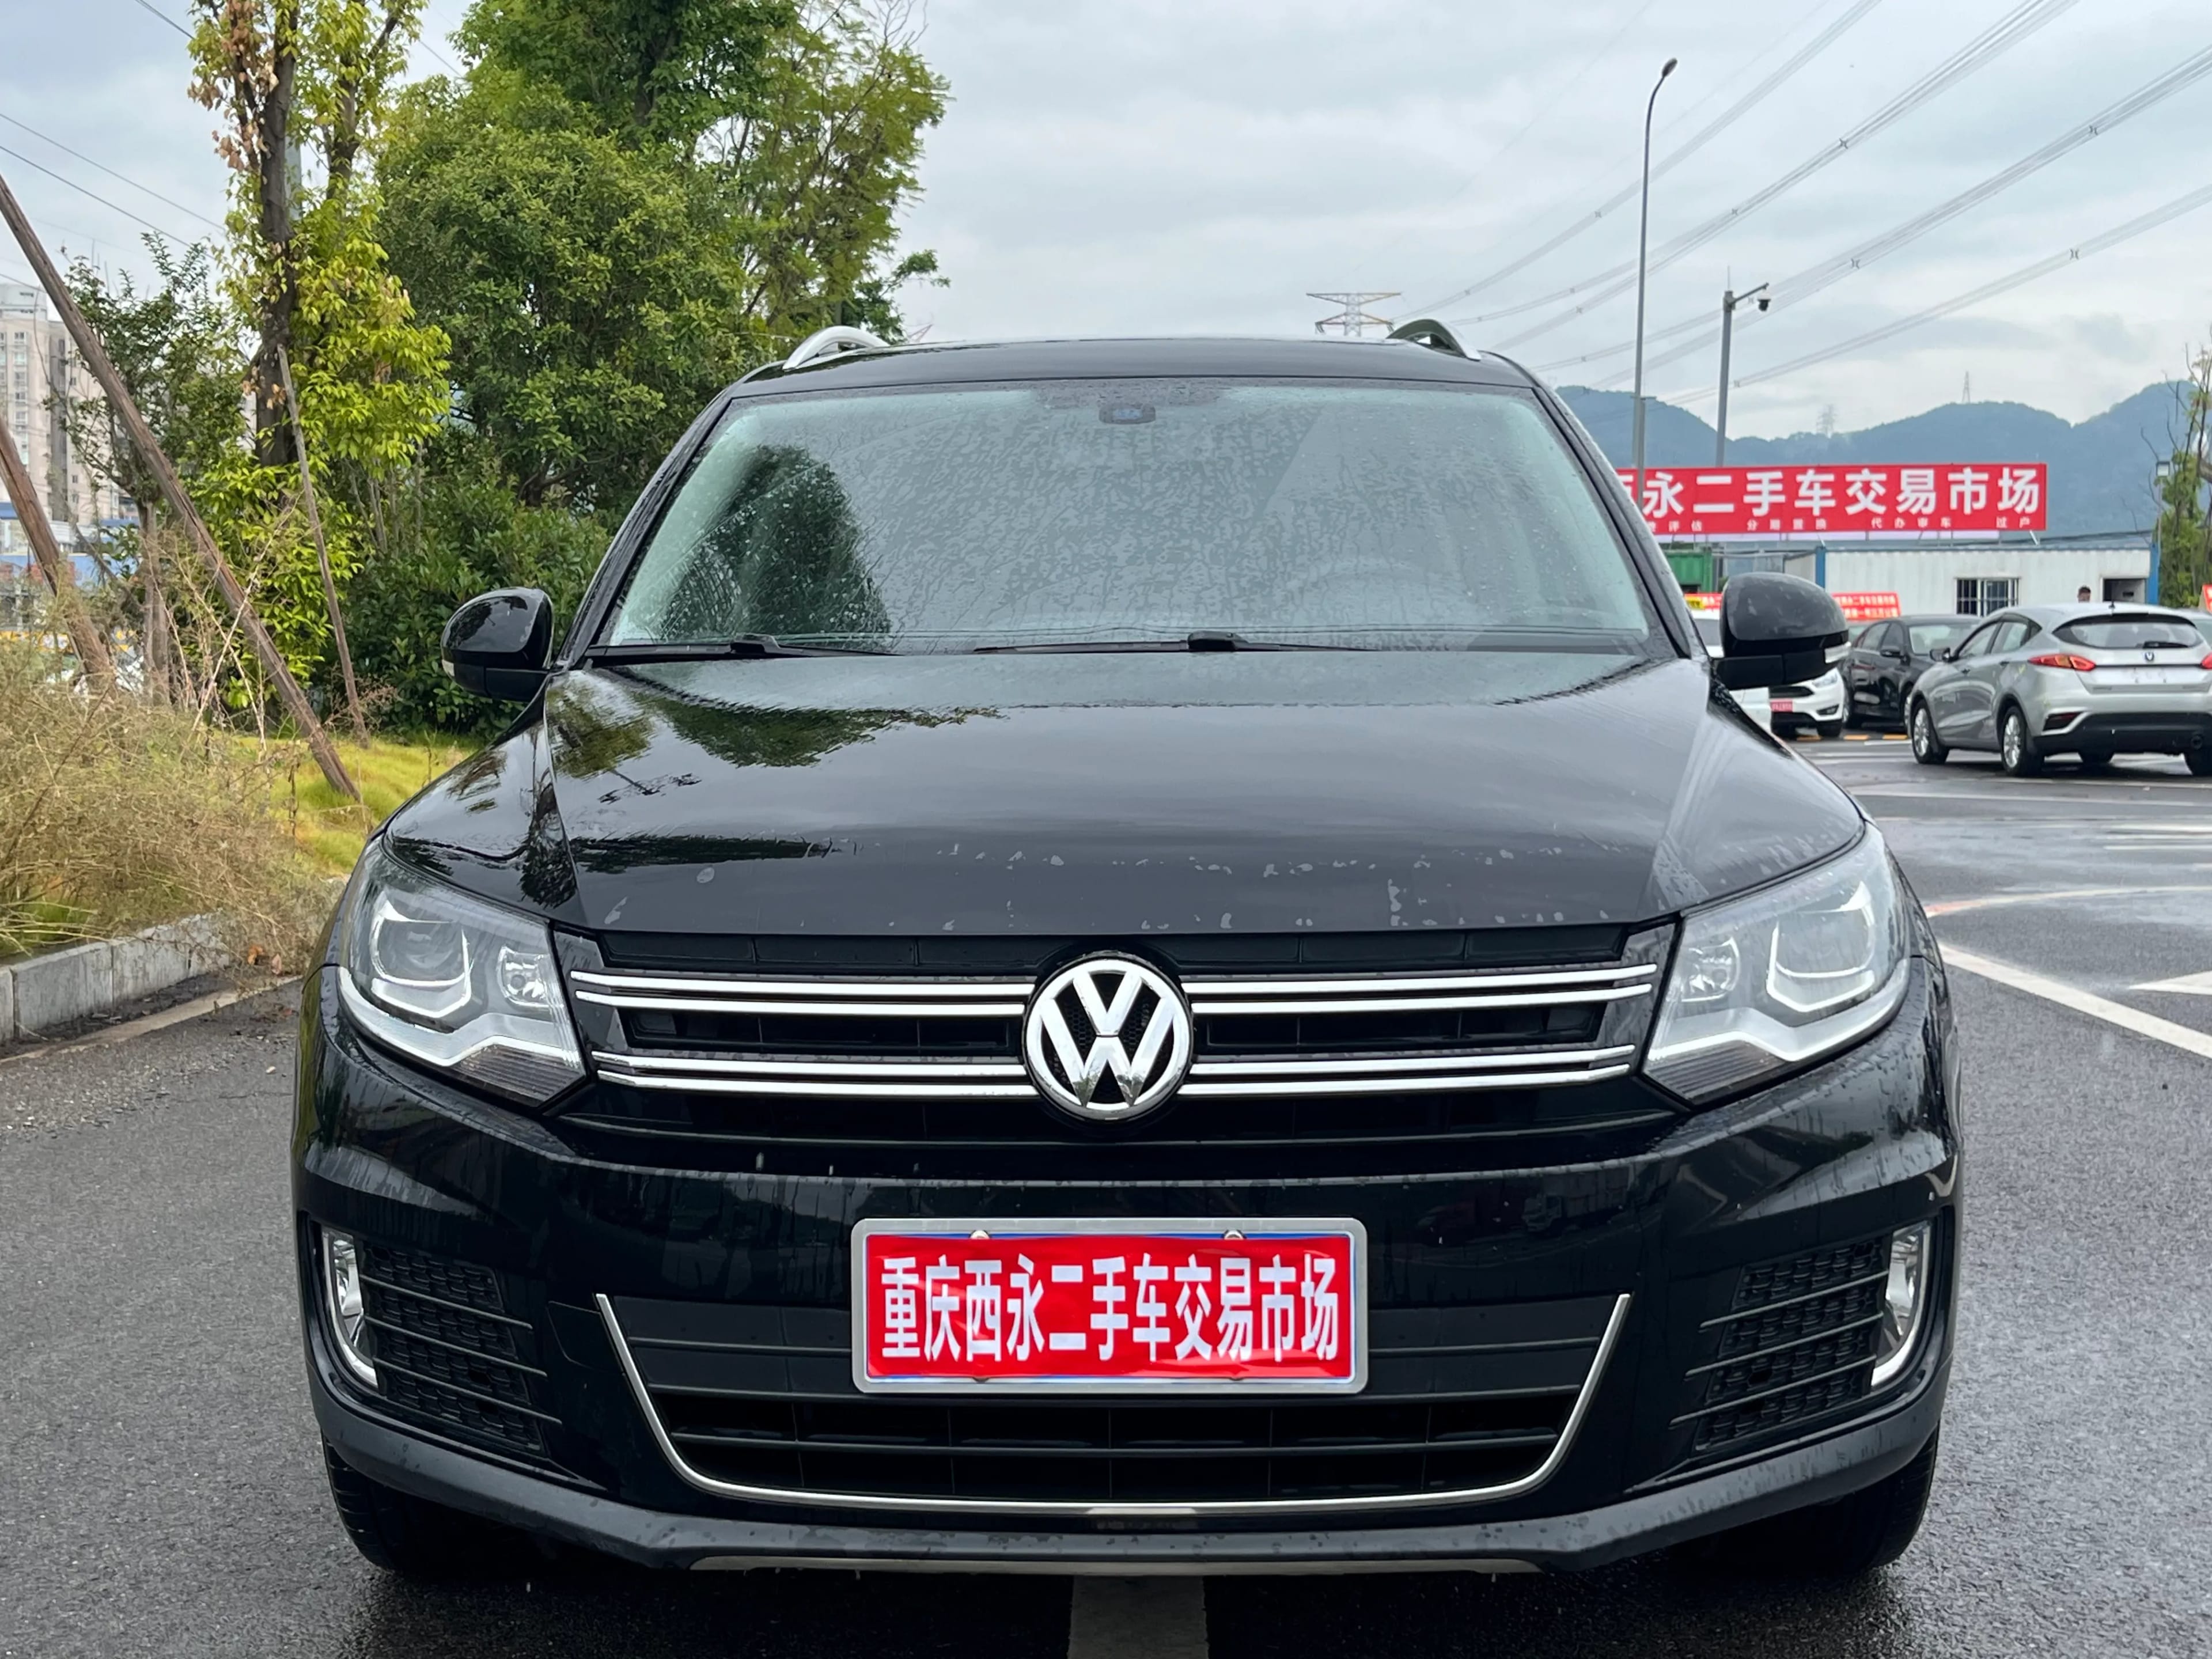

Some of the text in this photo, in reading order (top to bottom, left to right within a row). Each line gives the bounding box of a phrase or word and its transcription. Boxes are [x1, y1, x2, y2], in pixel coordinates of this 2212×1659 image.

[881, 1253, 1338, 1362] 重庆西永二手车交易市场
